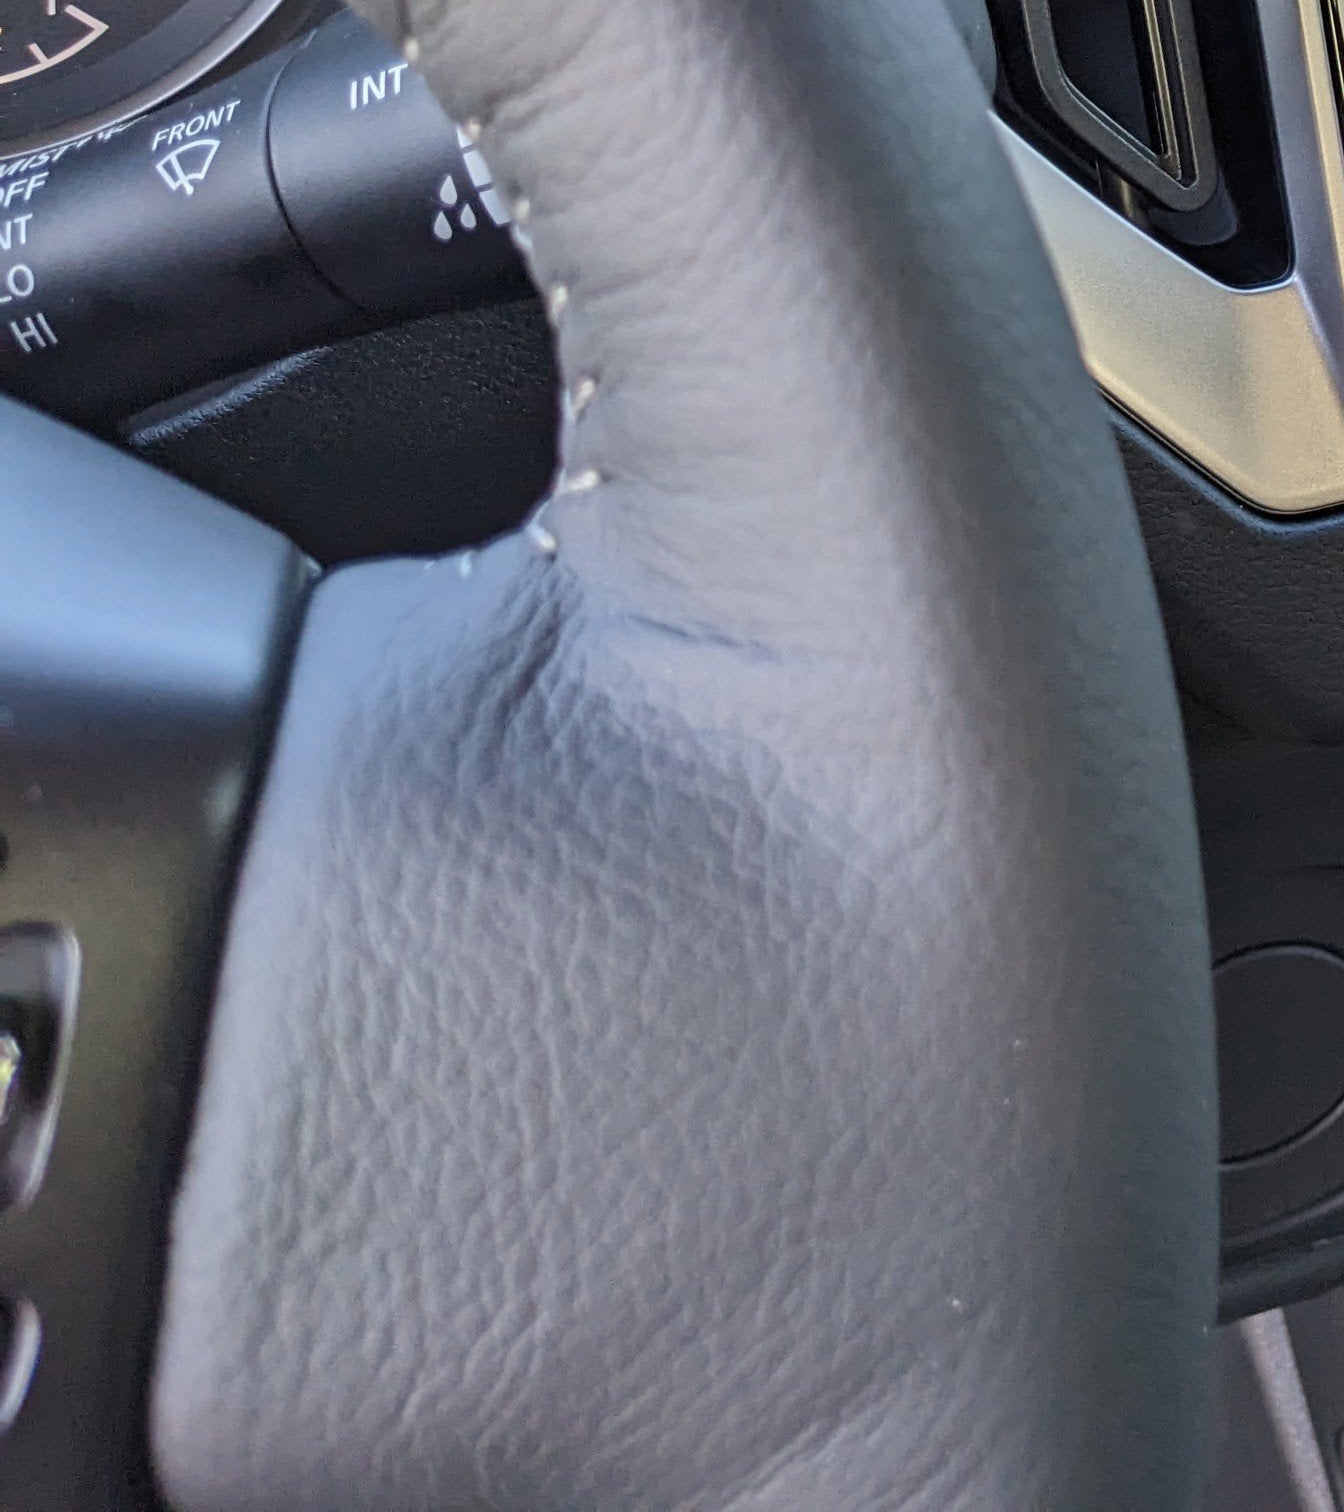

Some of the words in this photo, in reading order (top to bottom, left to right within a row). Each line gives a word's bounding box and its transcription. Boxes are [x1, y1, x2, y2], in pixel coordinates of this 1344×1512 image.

[349, 61, 408, 110] INT
[151, 99, 241, 151] FRONT
[10, 312, 58, 353] HI
